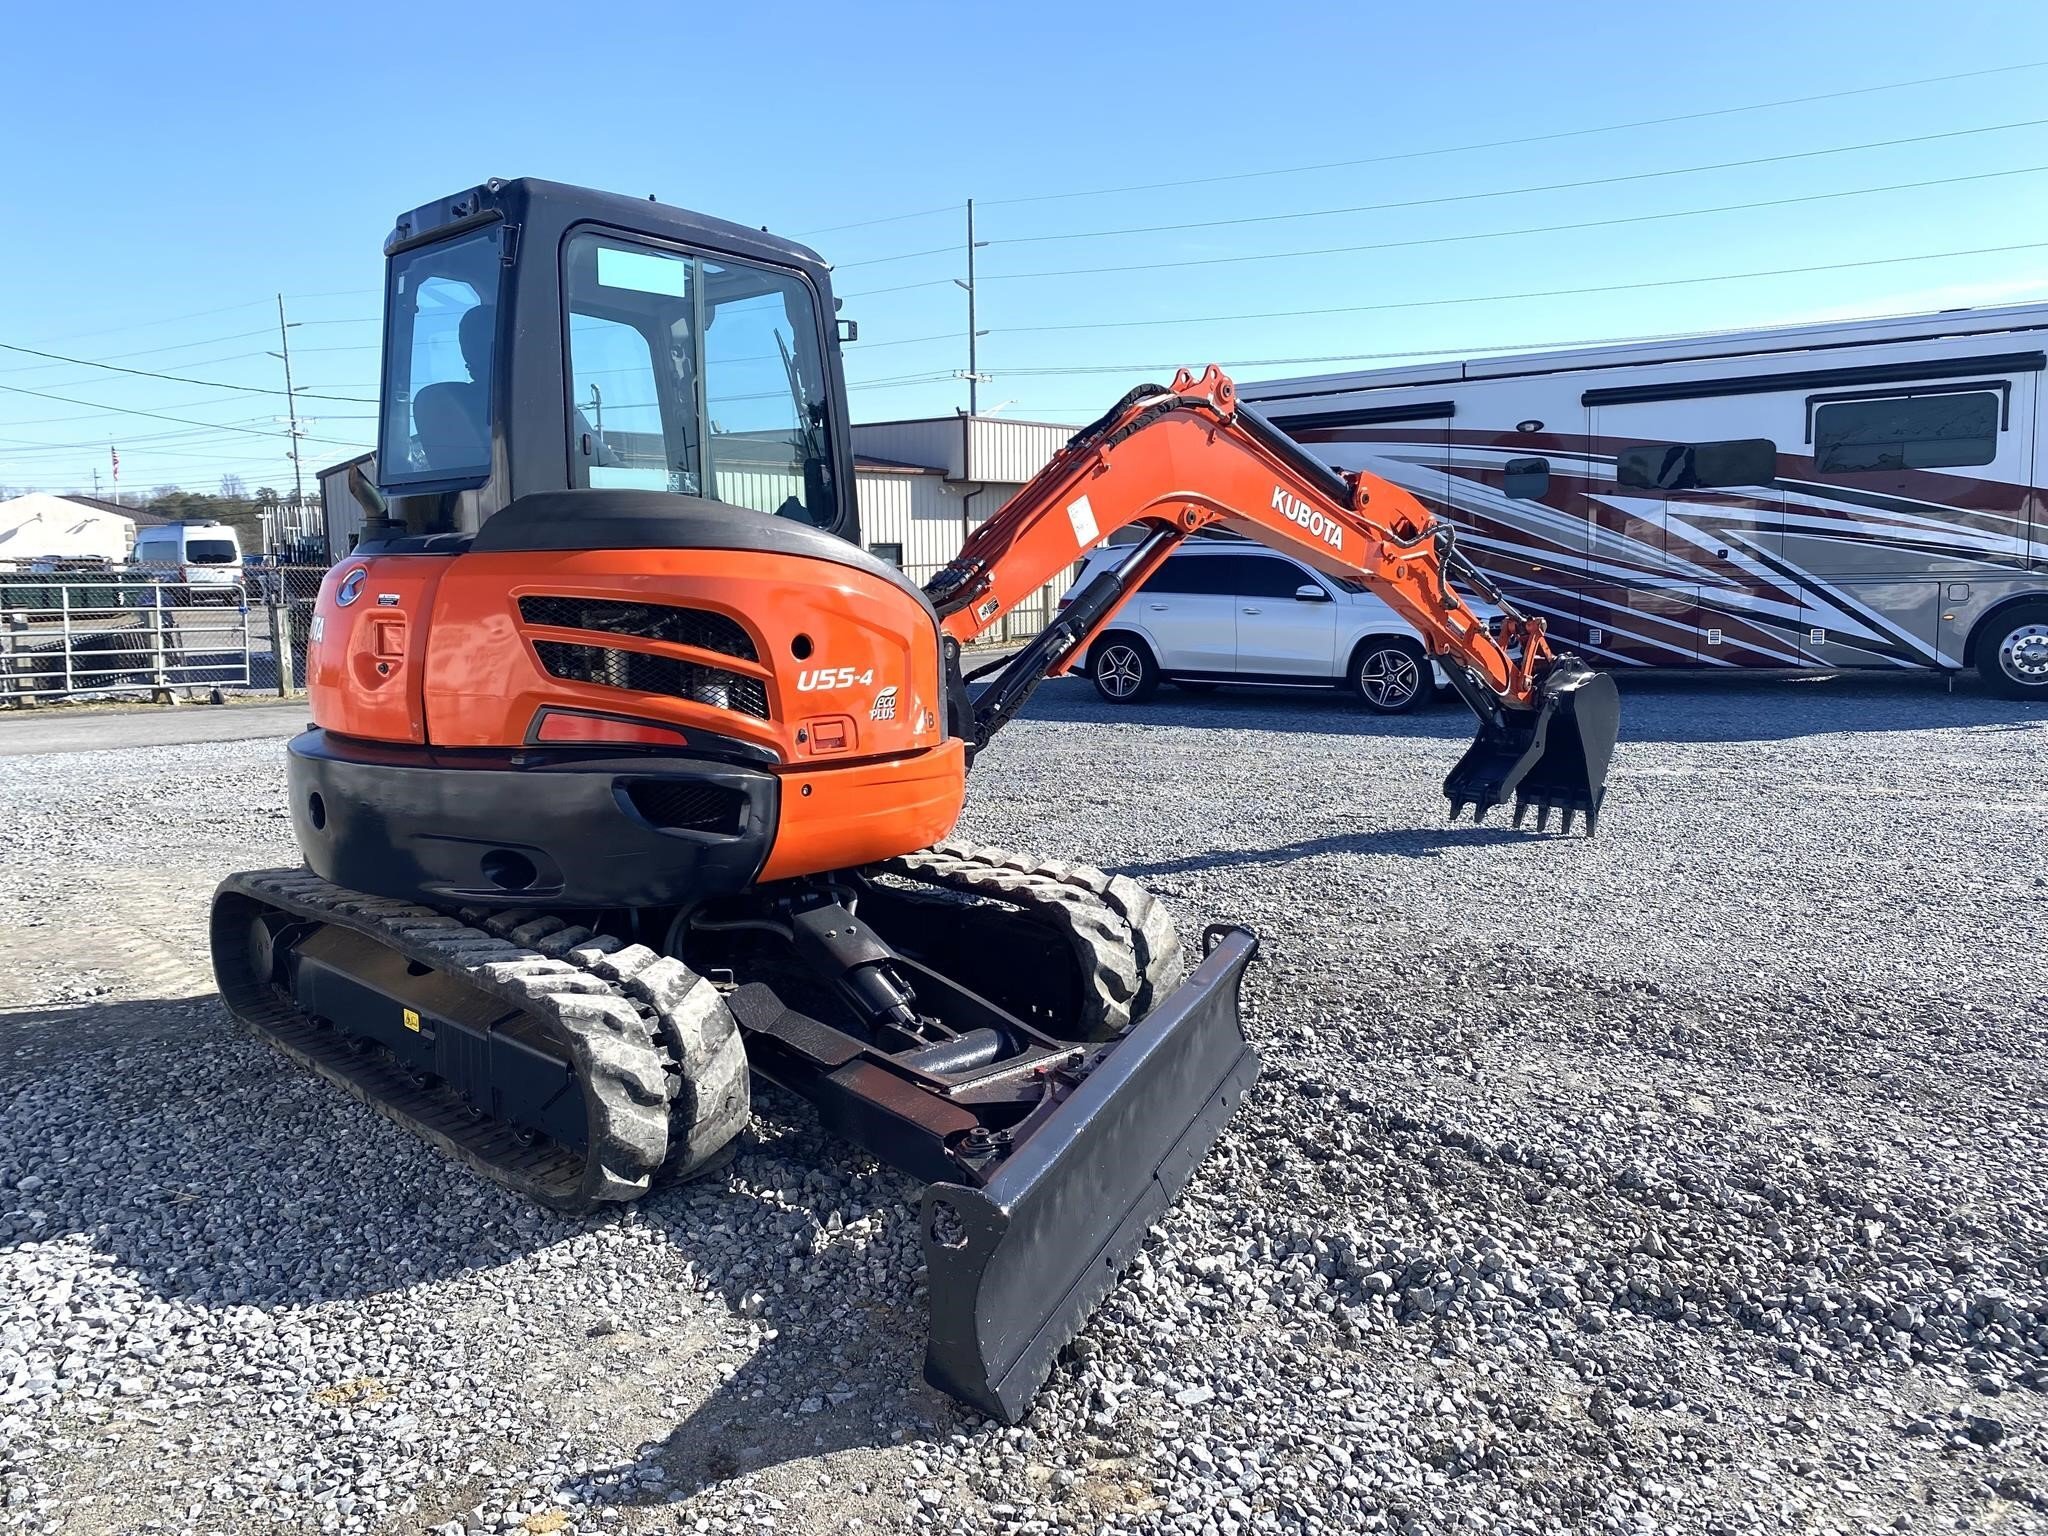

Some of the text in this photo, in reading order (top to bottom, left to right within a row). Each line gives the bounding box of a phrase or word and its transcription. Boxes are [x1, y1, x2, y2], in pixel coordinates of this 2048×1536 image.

[1271, 485, 1343, 551] KUBOTA
[796, 667, 874, 692] U55-4
[876, 697, 896, 708] eco
[870, 707, 896, 721] PLUS
